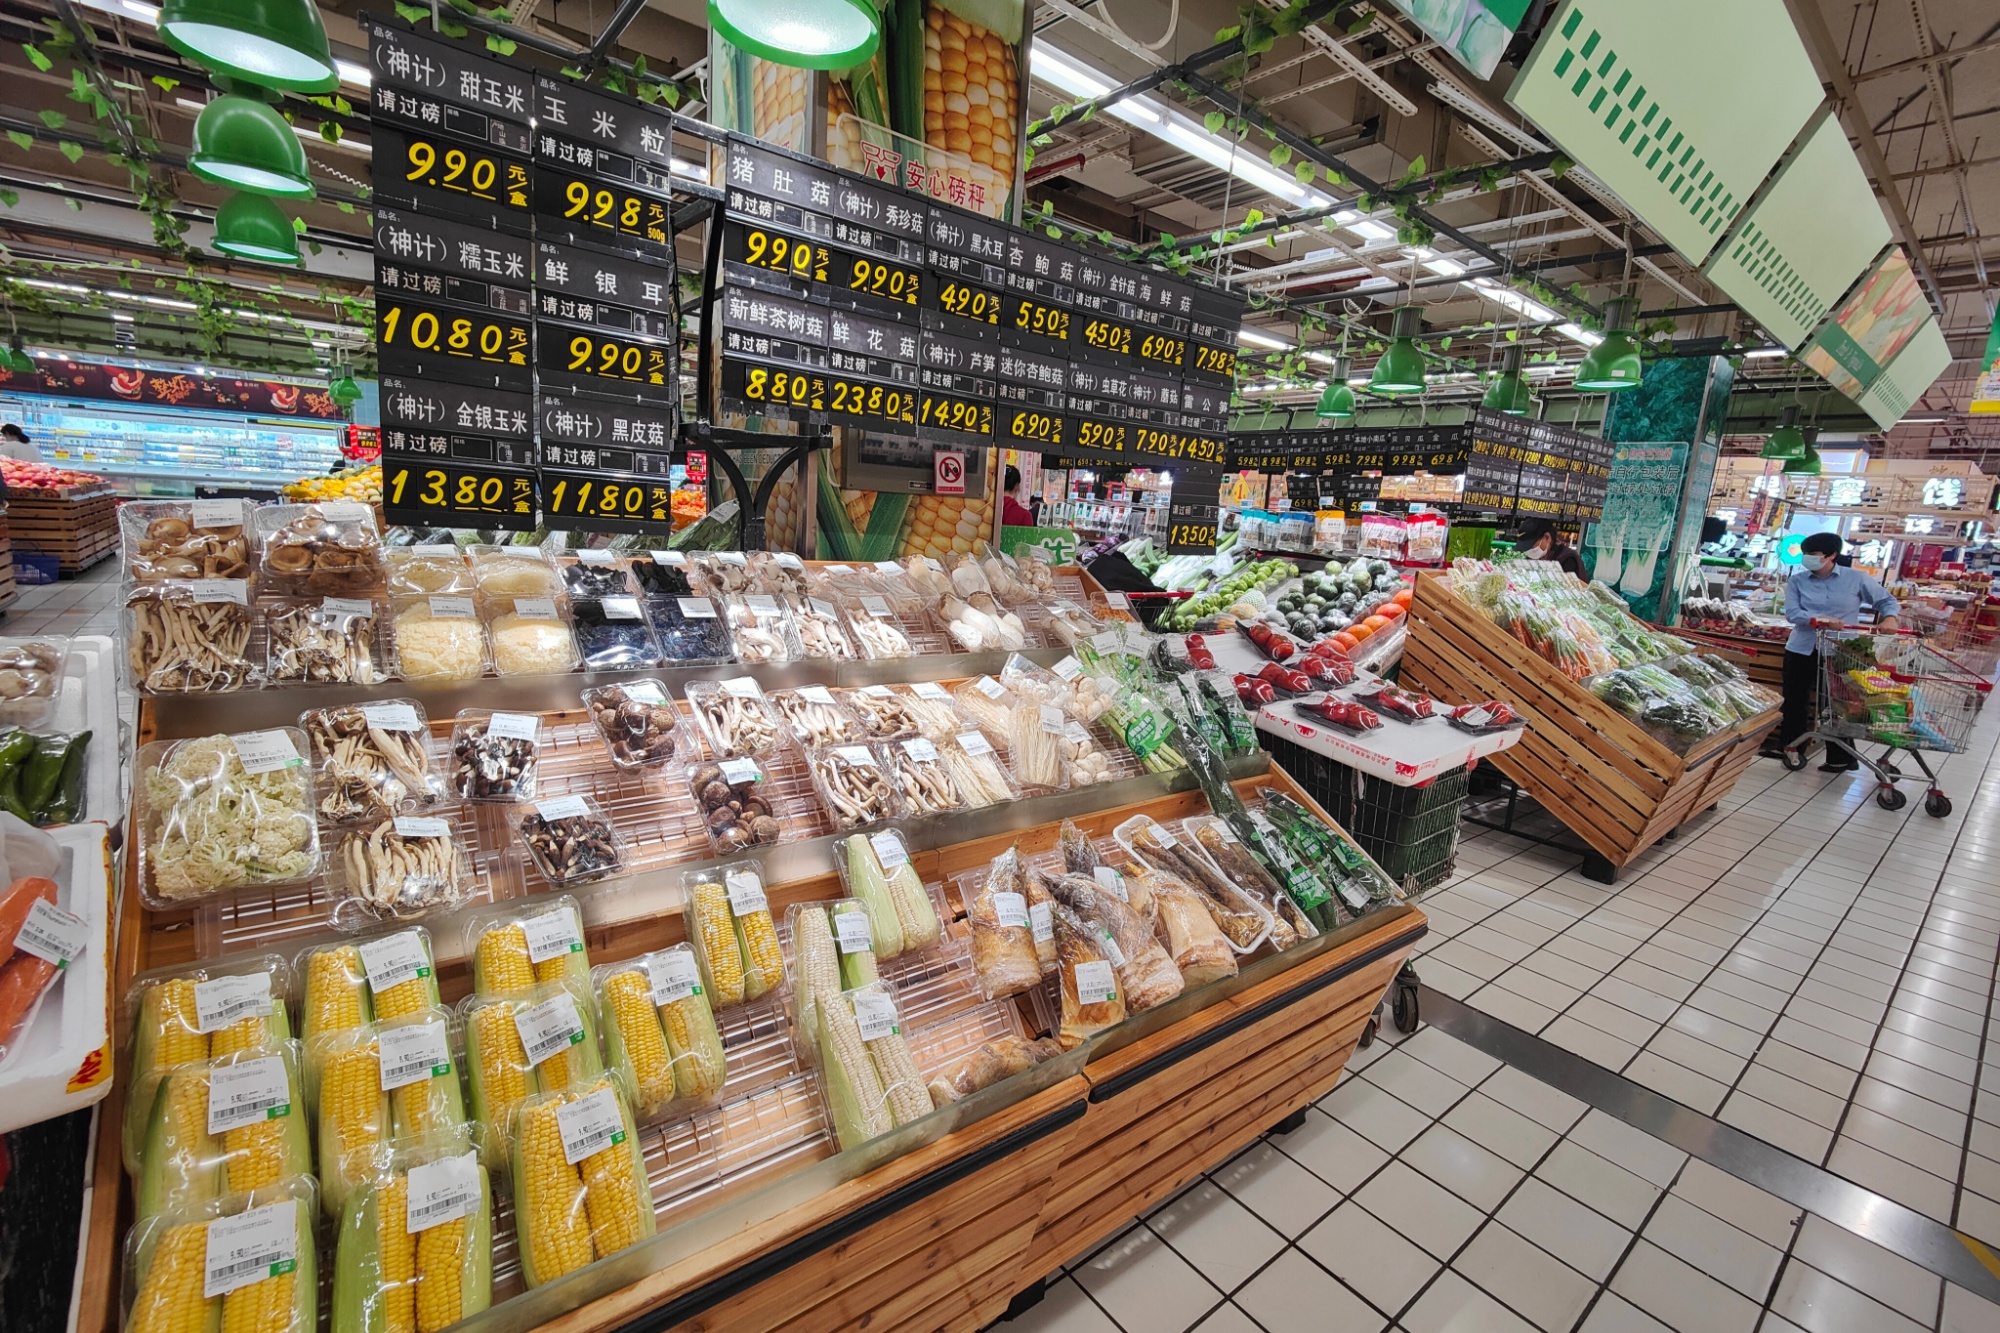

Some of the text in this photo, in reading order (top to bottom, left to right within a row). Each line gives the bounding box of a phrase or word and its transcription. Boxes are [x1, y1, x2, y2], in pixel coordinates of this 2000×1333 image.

[376, 45, 525, 113] （神计） 甜玉米
[377, 89, 440, 124] 请过磅
[406, 142, 495, 190] 9.90
[539, 135, 594, 168] 请过磅
[905, 161, 986, 212] 安心磅秤
[564, 181, 641, 227] 9.98
[730, 191, 773, 219] 请过磅
[838, 191, 924, 235] （神计） 秀珍菇
[746, 231, 811, 269] 9.90
[836, 222, 872, 248] 请过磅
[930, 221, 1004, 260] （神计） 黑木耳
[377, 226, 525, 280] （神计） 糯玉米
[928, 249, 960, 272] 请过磅
[380, 265, 442, 296] 请过磅
[850, 259, 905, 294] 9.90
[1008, 271, 1035, 292] 请过磅
[1077, 266, 1137, 296] （神计） 金针菇
[541, 295, 594, 322] 请过磅
[941, 283, 986, 315] 4.90
[1076, 292, 1101, 310] 请过磅
[383, 307, 503, 352] 10.80
[729, 296, 824, 339] 新鲜茶树菇
[1016, 302, 1060, 331] 5.50
[727, 333, 769, 355] 请过磅
[1085, 321, 1121, 347] 4.50
[1141, 335, 1175, 359] 6.90
[568, 336, 641, 374] 9.90
[832, 352, 867, 372] 请过磅
[921, 344, 996, 374] （神计） 芦笋
[1196, 347, 1227, 370] 7.98
[745, 368, 808, 401] 8.80
[922, 369, 953, 389] 请过磅
[1000, 356, 1064, 386] 迷你杏鲍菇
[386, 393, 528, 434] （神计） 金银玉米
[831, 382, 900, 415] 23.80
[921, 398, 978, 427] 14.90
[545, 410, 665, 447] （神计） 黑皮菇
[1011, 412, 1050, 437] 6.90
[1078, 422, 1114, 446] 5.90
[387, 432, 448, 454] 请过磅
[1136, 429, 1168, 451] 7.90
[1178, 437, 1215, 458] 14.50
[545, 446, 597, 467] 请过磅
[743, 453, 758, 464] BEEN
[391, 469, 503, 506] 13.80
[552, 480, 643, 515] 11.80
[1170, 525, 1208, 546] 13.50
